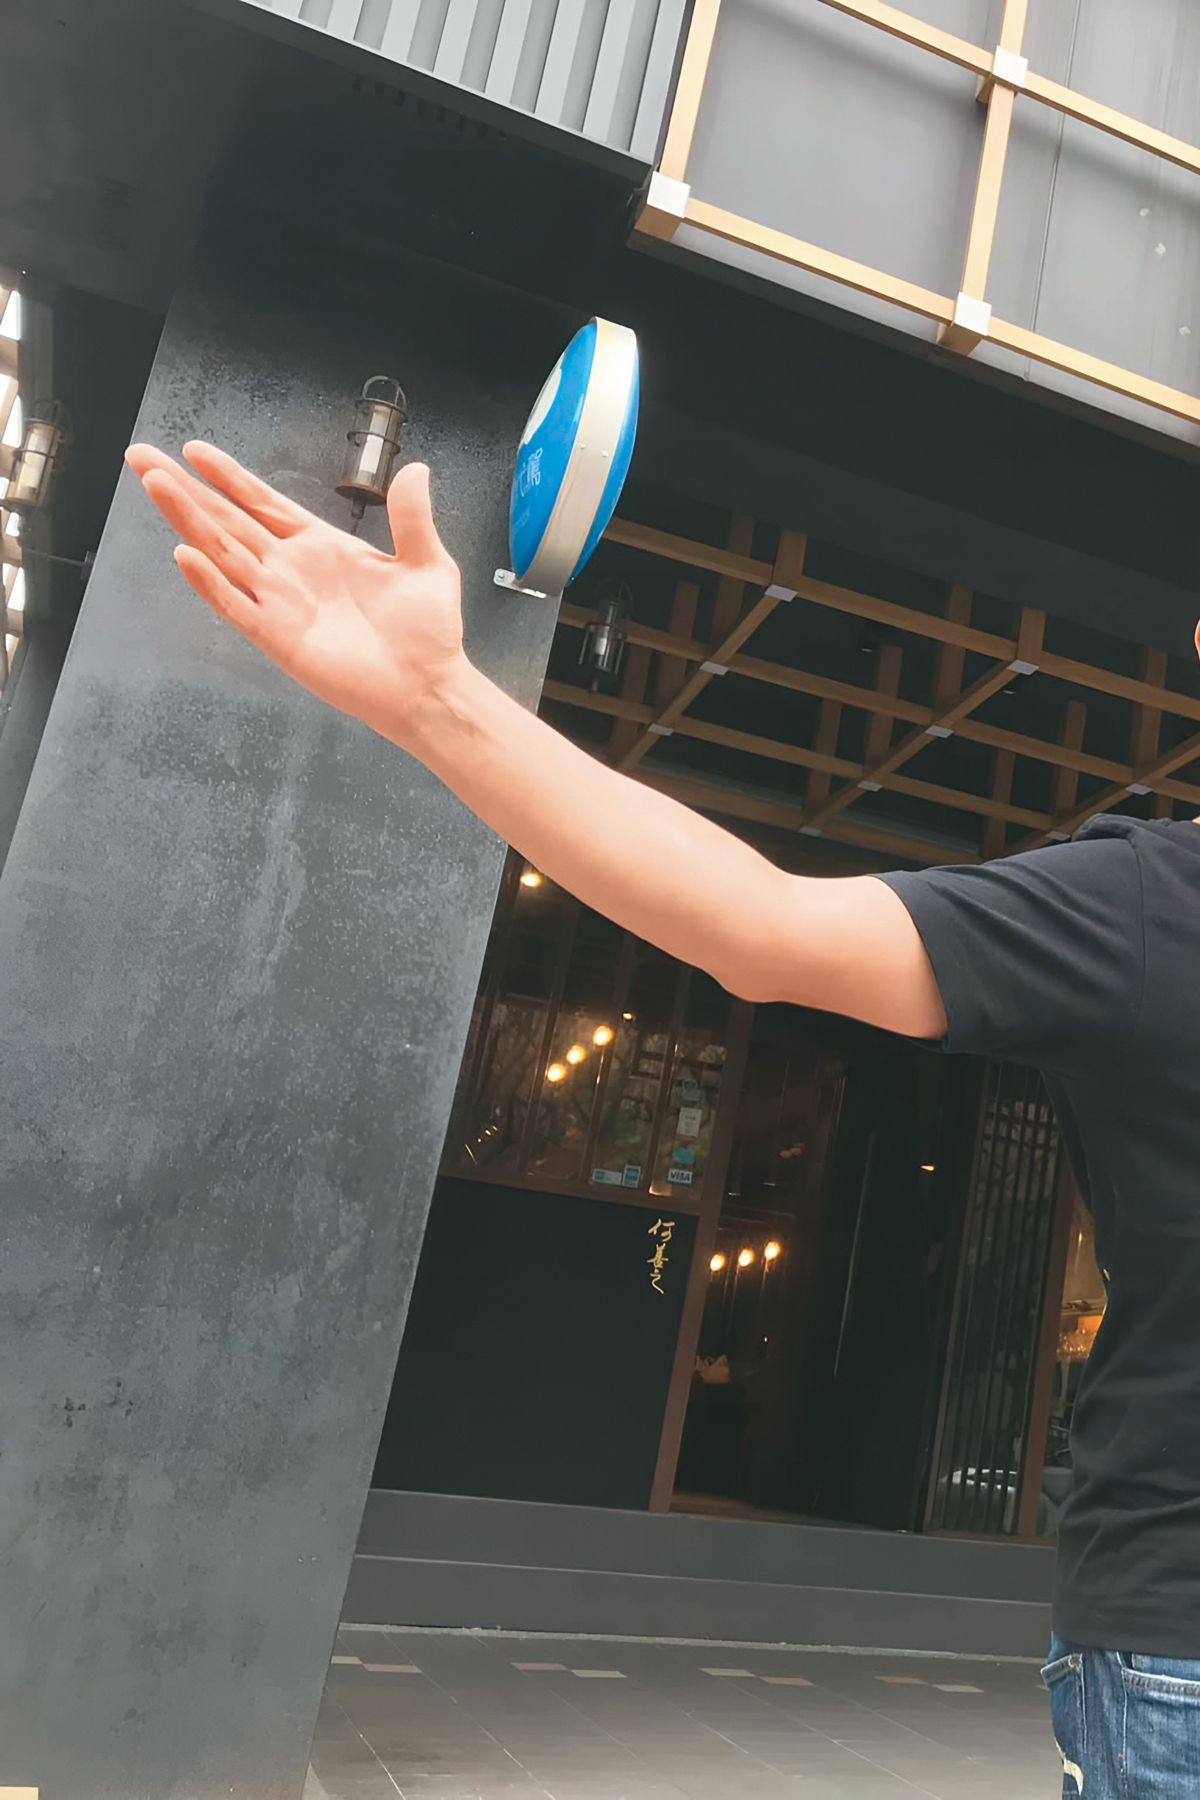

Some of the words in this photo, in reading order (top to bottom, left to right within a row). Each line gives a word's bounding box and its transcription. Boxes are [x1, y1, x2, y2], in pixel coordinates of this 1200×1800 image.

[669, 1170, 691, 1183] VISA
[647, 1217, 677, 1295] 何善之
